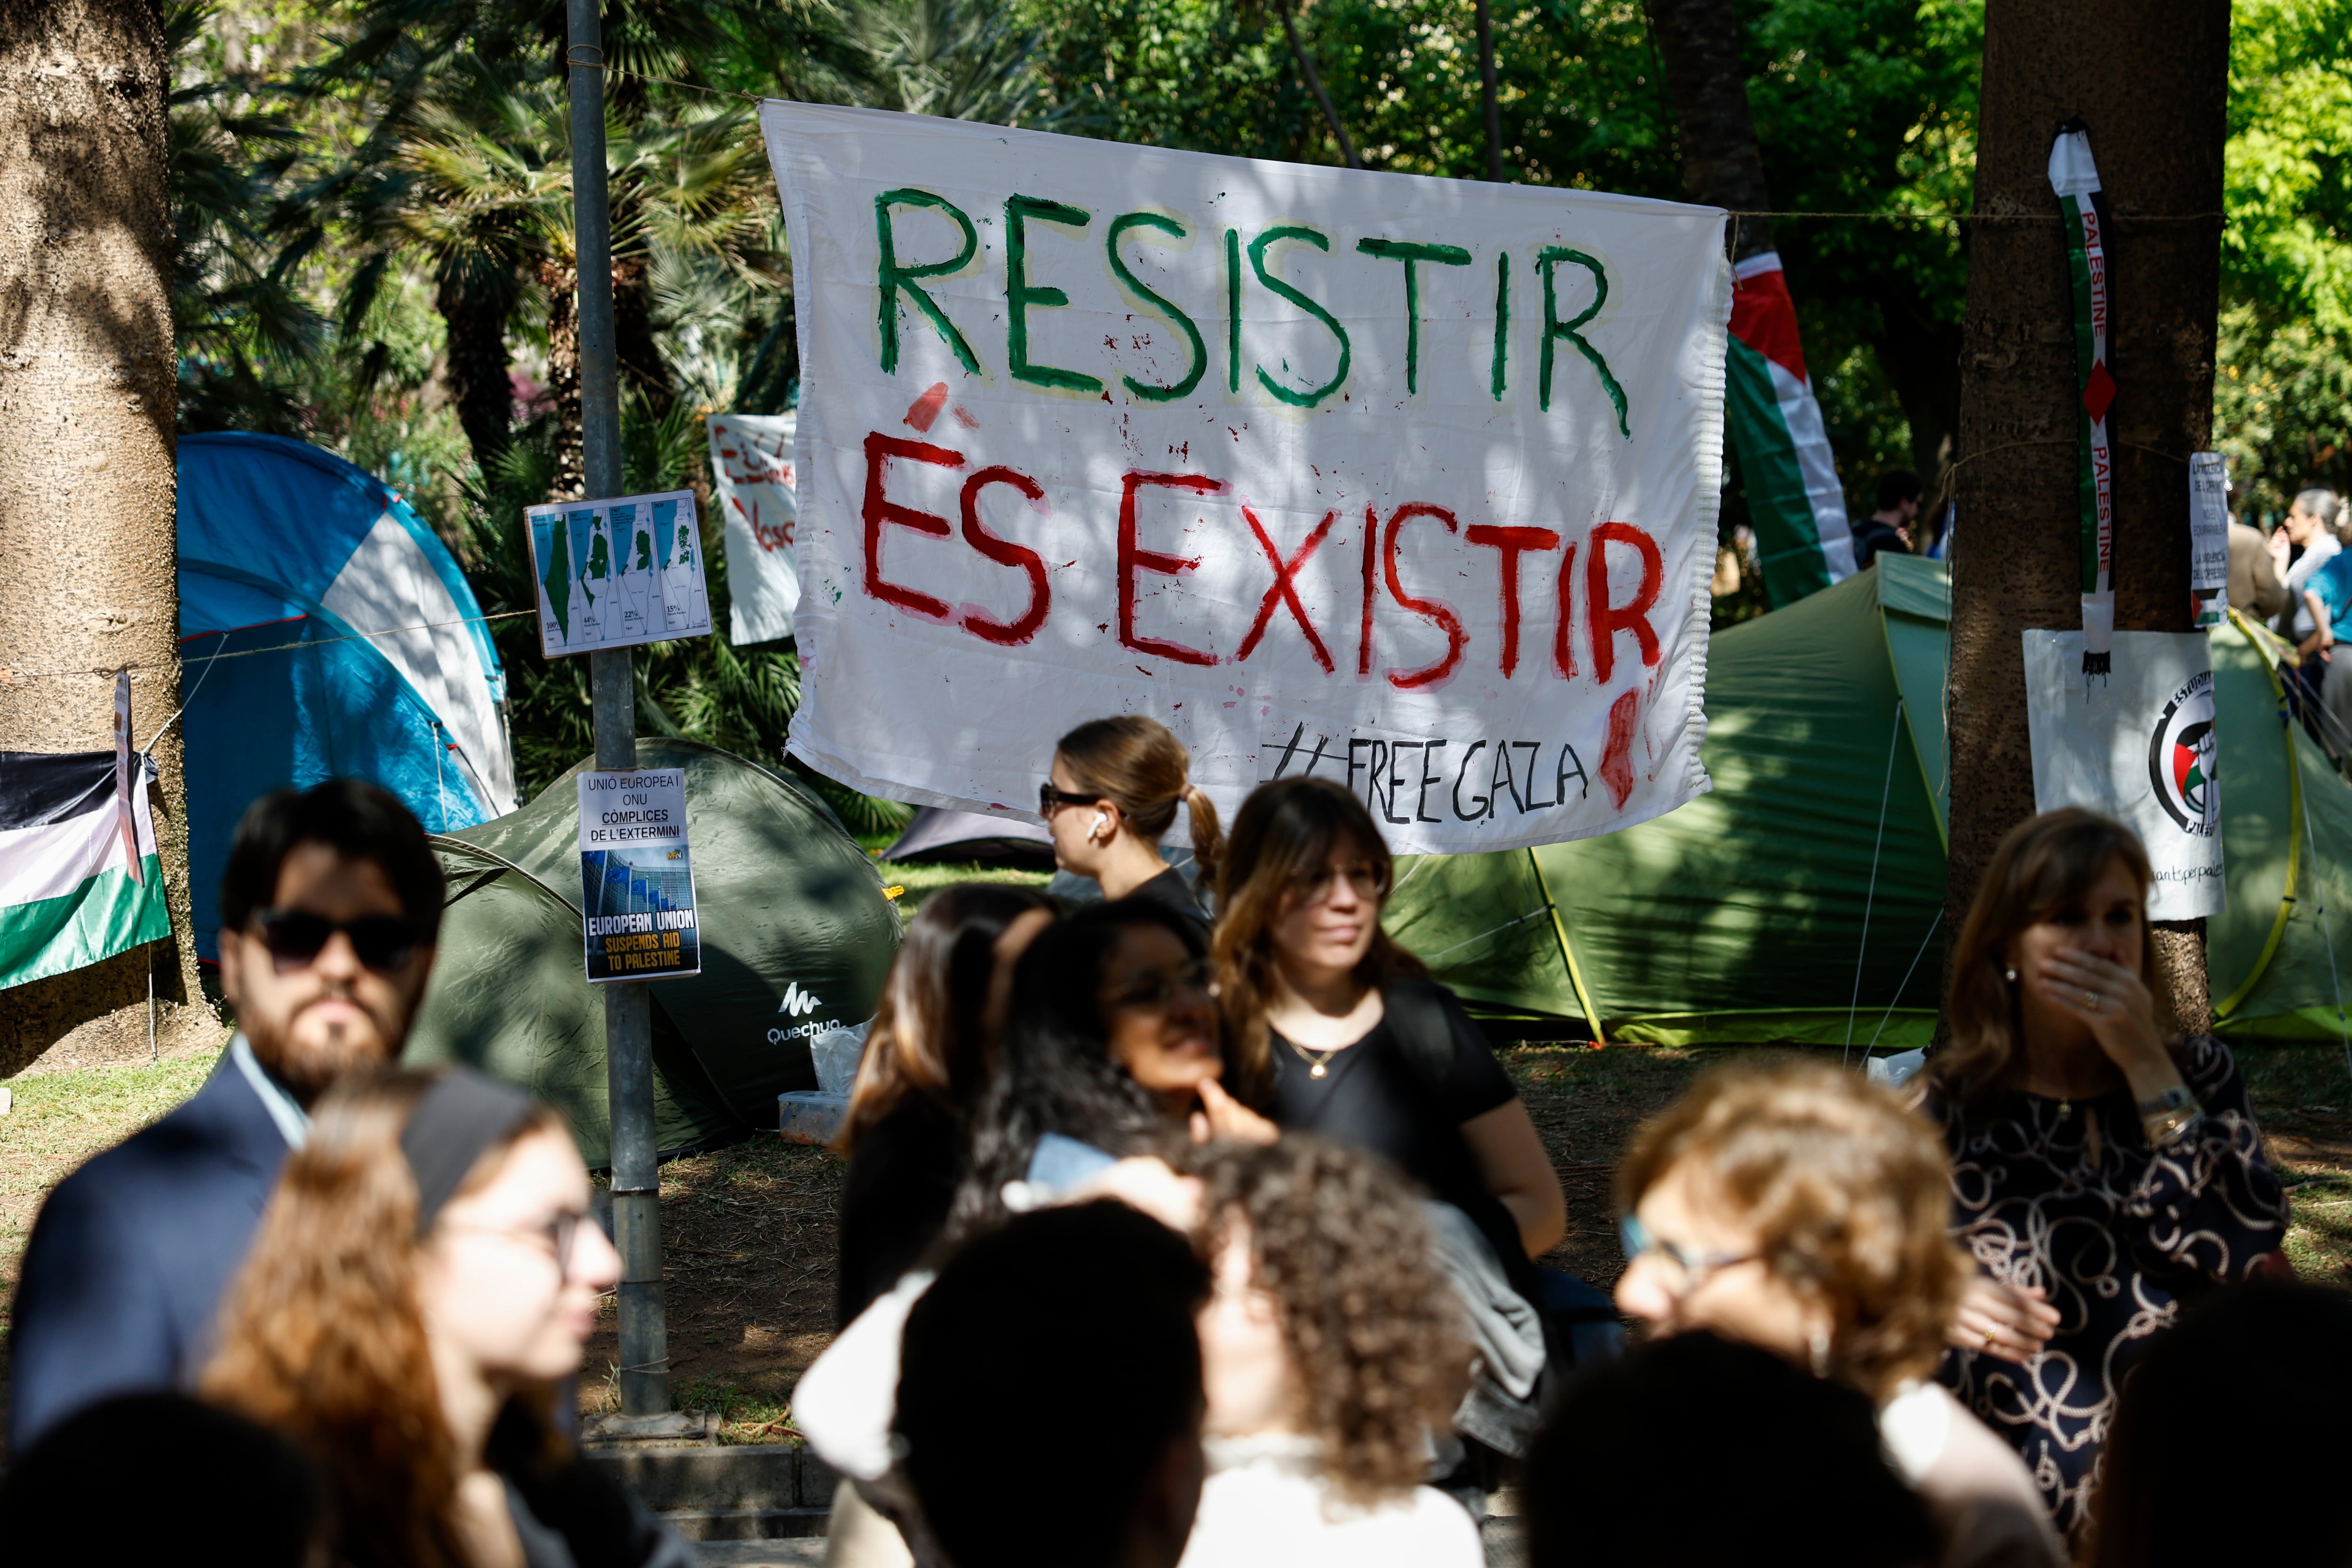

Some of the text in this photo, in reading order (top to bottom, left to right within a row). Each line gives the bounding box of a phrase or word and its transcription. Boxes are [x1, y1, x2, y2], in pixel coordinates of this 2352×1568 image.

[2082, 212, 2106, 337] PALESTINE
[875, 188, 1630, 439] RESISTIR
[2093, 446, 2111, 573] PALESTINE
[863, 382, 1663, 689] ÉS EXISTIR
[2172, 671, 2212, 707] ESTUDIA
[588, 775, 679, 790] UNIÓ EUROPEA I
[623, 794, 647, 805] ONU
[602, 809, 668, 824] CÒMPLICES
[2185, 820, 2213, 836] PALES
[591, 825, 680, 841] DE L'EXTERMINI
[588, 909, 694, 936] EUROPEAN UNION
[605, 931, 681, 953] SUSPENDS AID
[608, 949, 680, 971] TO PALESTINE
[767, 1019, 841, 1045] Quechua
